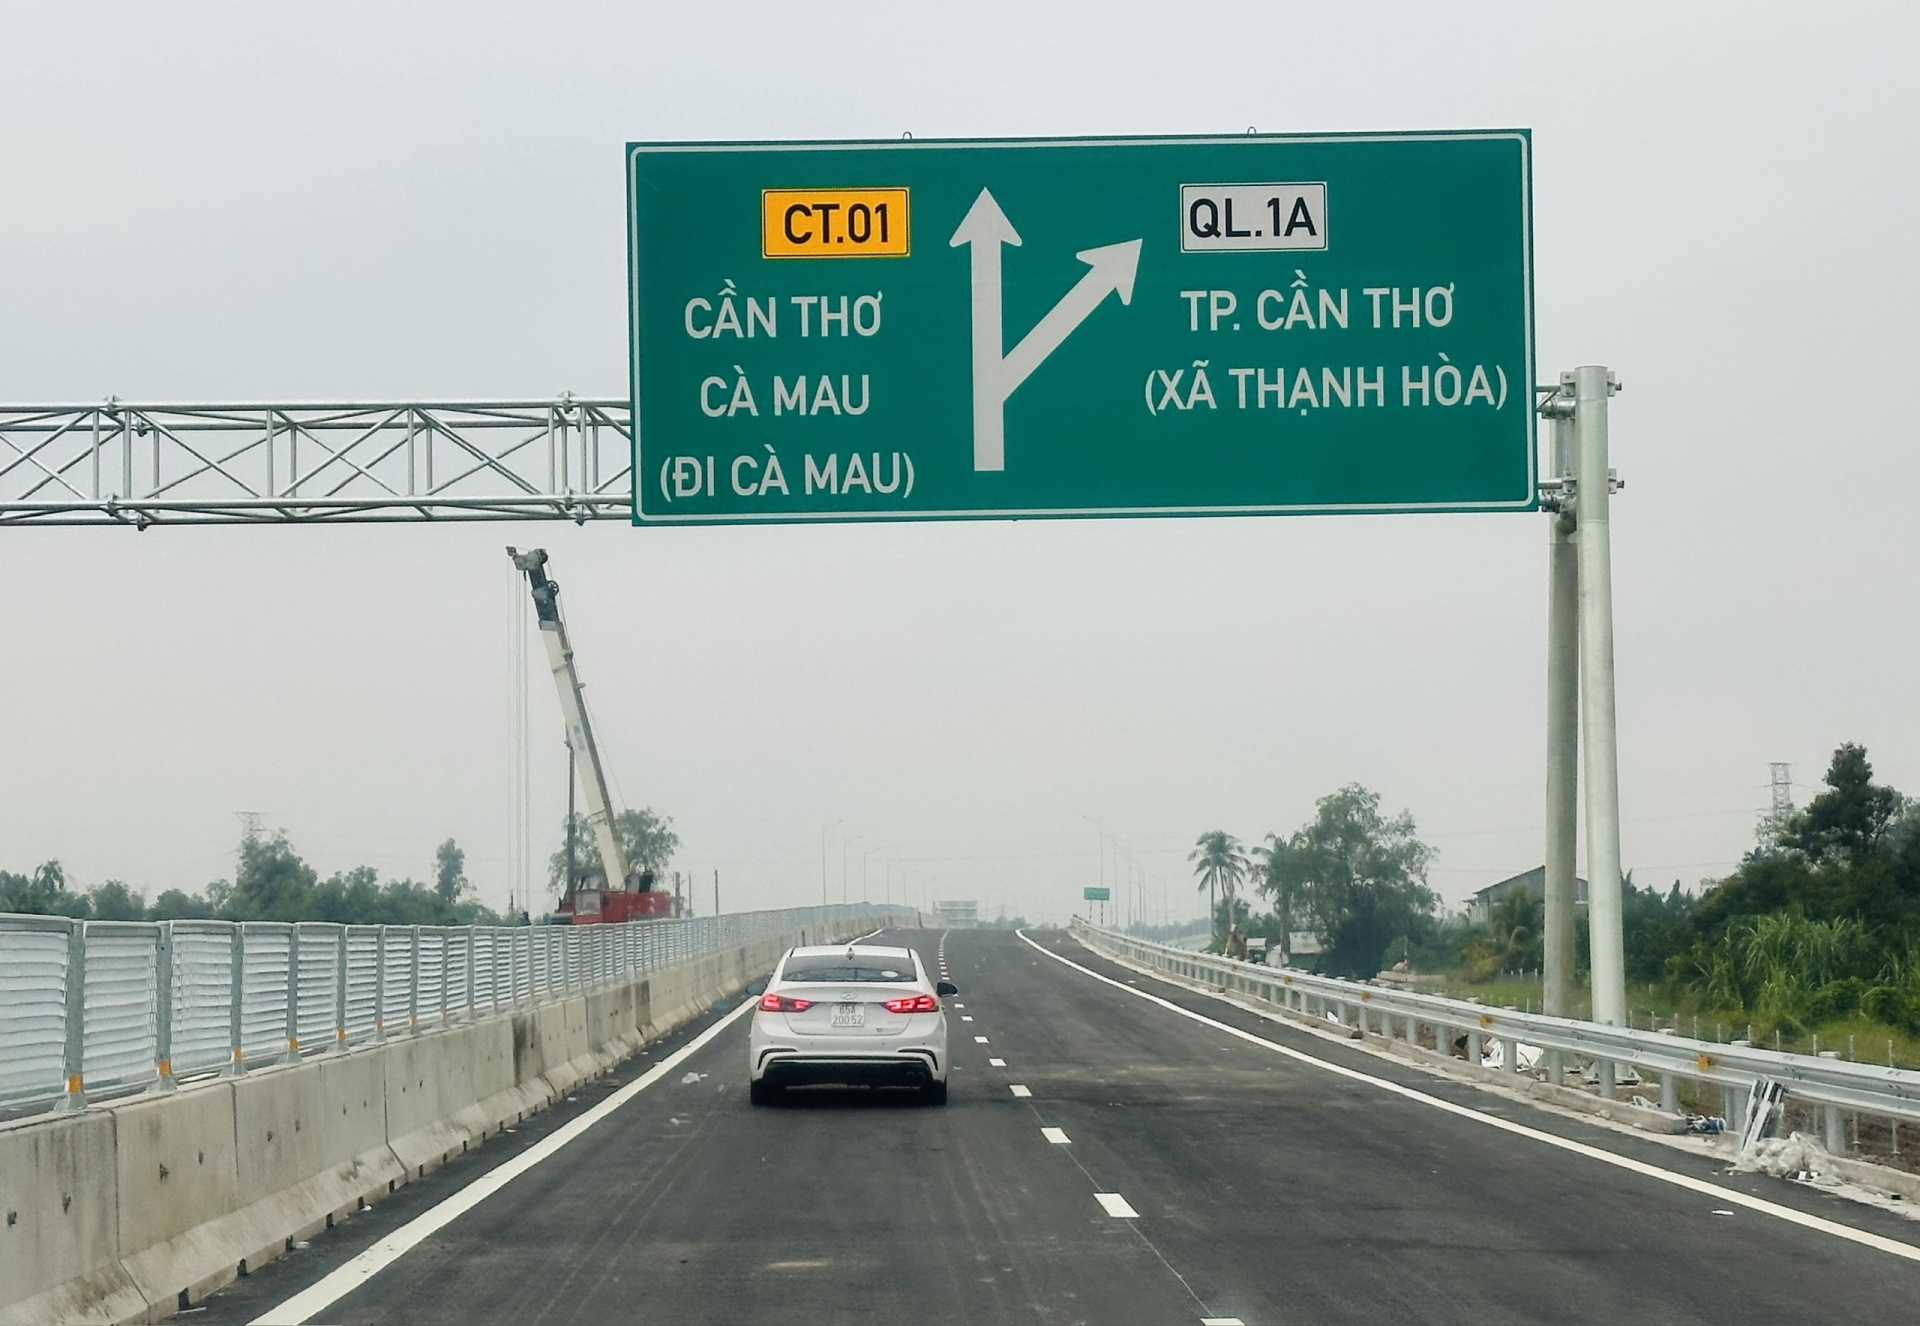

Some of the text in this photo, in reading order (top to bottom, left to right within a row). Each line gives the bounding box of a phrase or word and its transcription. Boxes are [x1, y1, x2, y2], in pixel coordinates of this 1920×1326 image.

[785, 204, 888, 244] CT.01
[1190, 197, 1318, 239] QL.1A
[686, 279, 882, 339] CẦN THƠ
[1181, 270, 1454, 331] TP. CẦN THƠ
[701, 366, 869, 416] CÀ MAU
[1146, 353, 1506, 416] (XÃ THẠNH HÒA)
[661, 445, 915, 502] (ĐI CÀ MAU)
